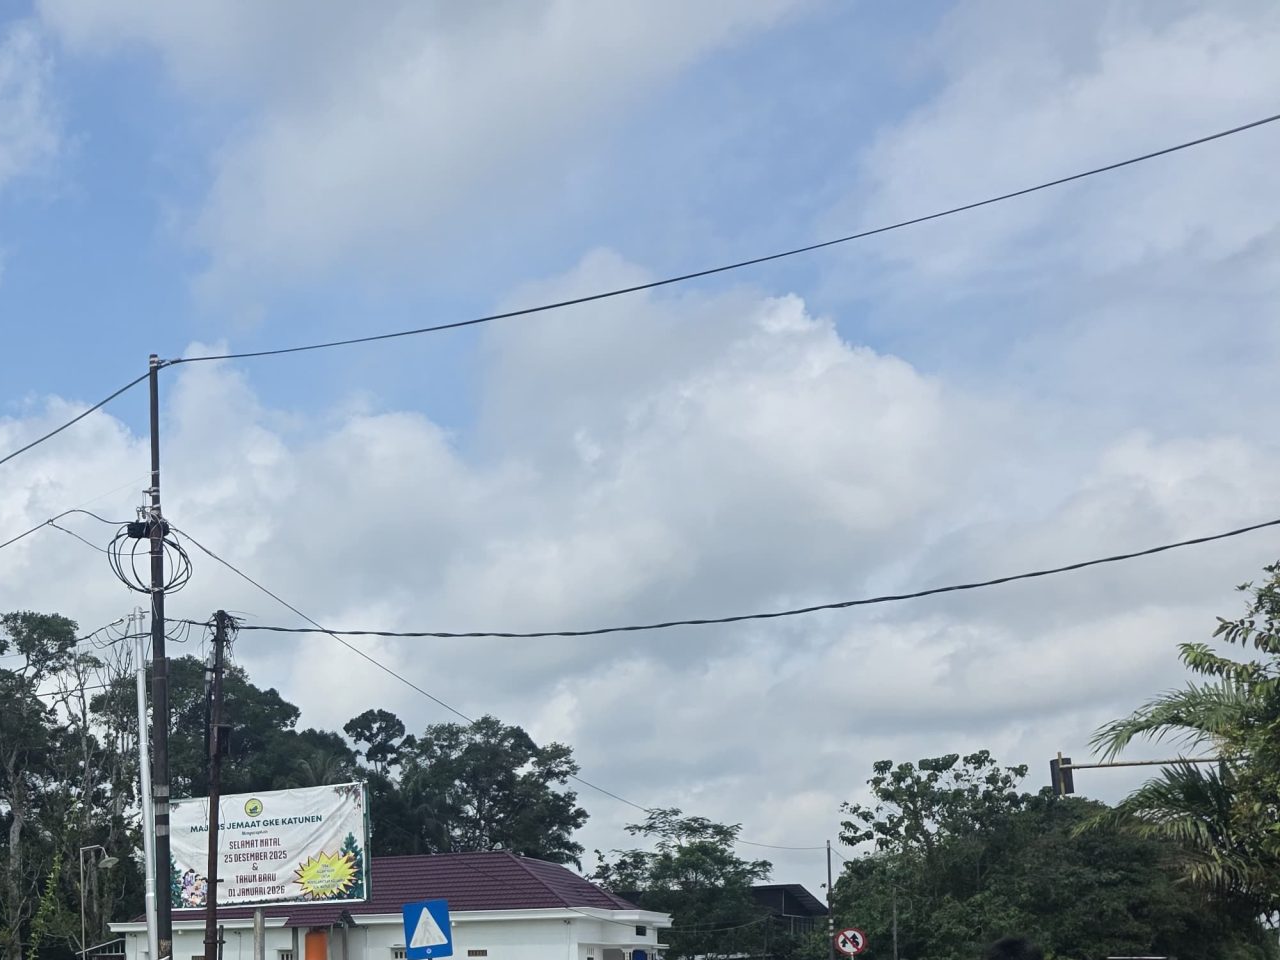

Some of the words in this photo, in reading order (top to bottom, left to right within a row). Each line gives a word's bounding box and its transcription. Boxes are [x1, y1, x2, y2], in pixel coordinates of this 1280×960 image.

[190, 823, 225, 833] MAJIS
[227, 819, 260, 830] JEMAAT
[263, 818, 279, 827] GKE
[281, 815, 322, 826] KATUNEN
[229, 839, 258, 850] SELAMAT
[260, 837, 281, 848] NATAL
[224, 854, 233, 863] 25
[234, 851, 268, 863] DESEMBER
[269, 850, 288, 860] 2025
[252, 862, 258, 871] &
[235, 873, 257, 884] TAHUN
[258, 873, 277, 883] BARU
[228, 888, 236, 897] 01
[237, 886, 266, 897] JANUARI
[267, 885, 286, 895] 2026
